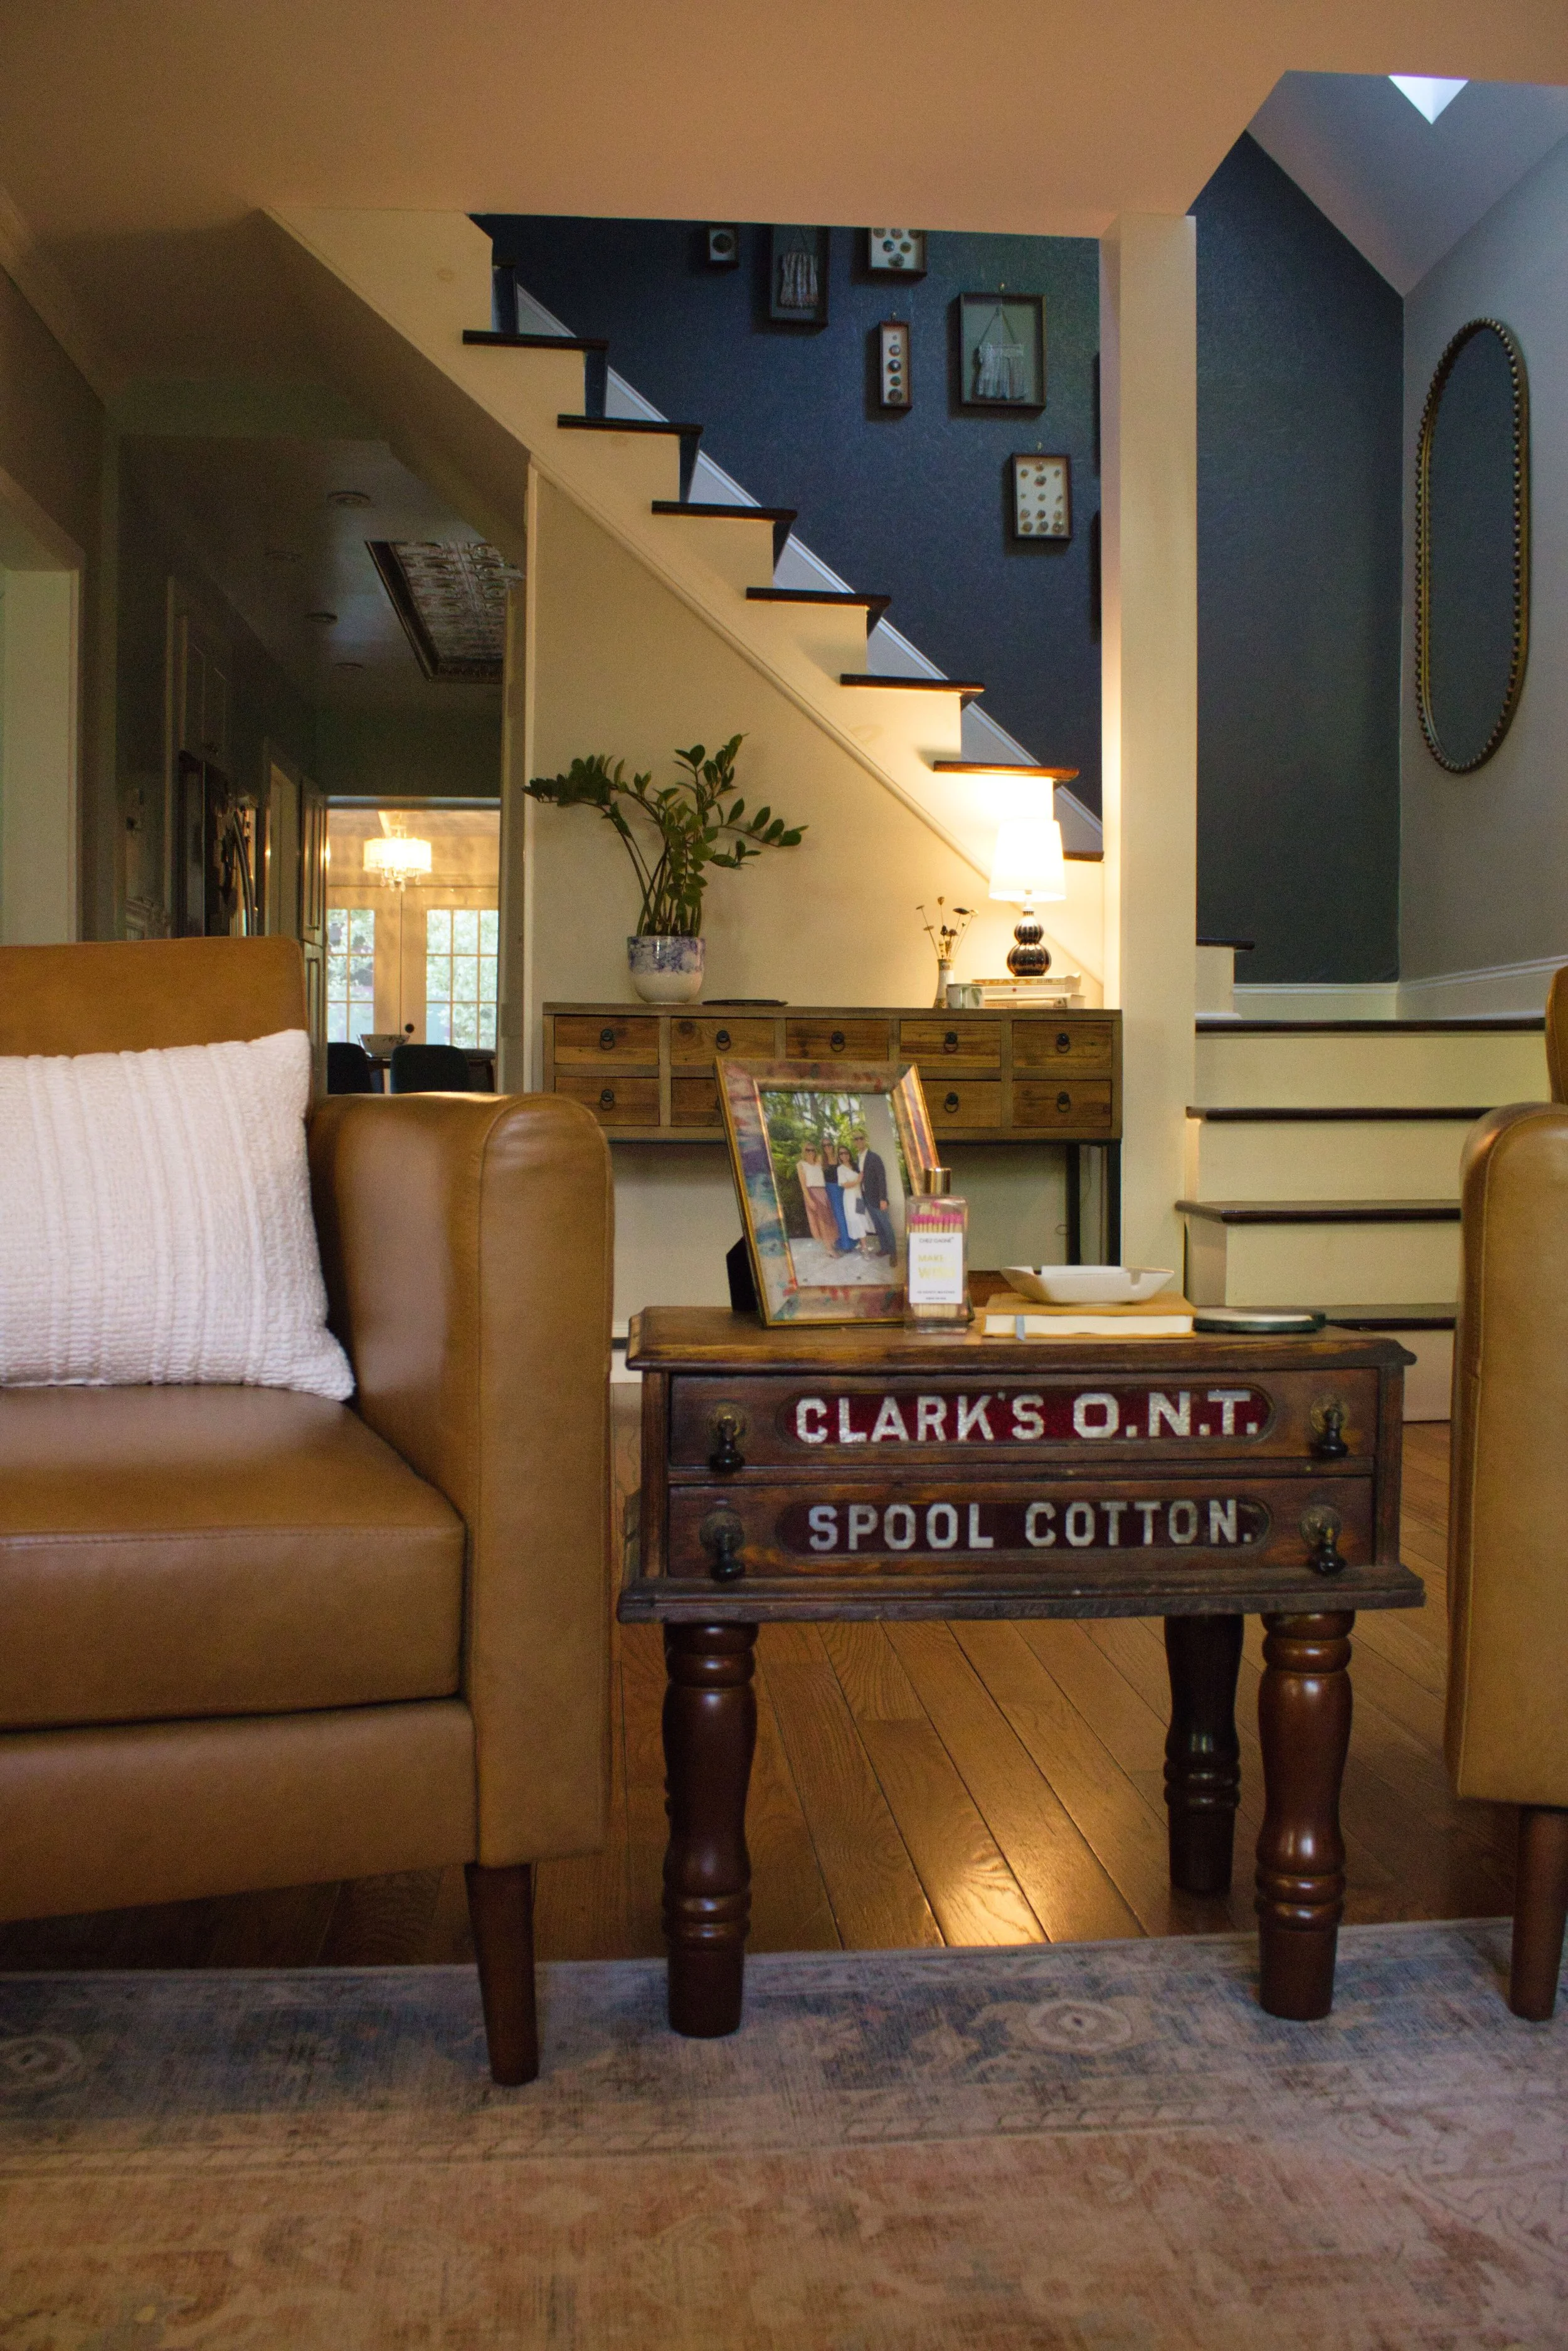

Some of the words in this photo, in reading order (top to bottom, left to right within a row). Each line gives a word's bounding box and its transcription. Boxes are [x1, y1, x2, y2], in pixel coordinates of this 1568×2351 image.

[795, 1392, 1045, 1445] CLARK'S
[1072, 1389, 1258, 1439] O.N.T.
[808, 1503, 994, 1550] SPOOL
[1024, 1499, 1252, 1547] COTTON.
